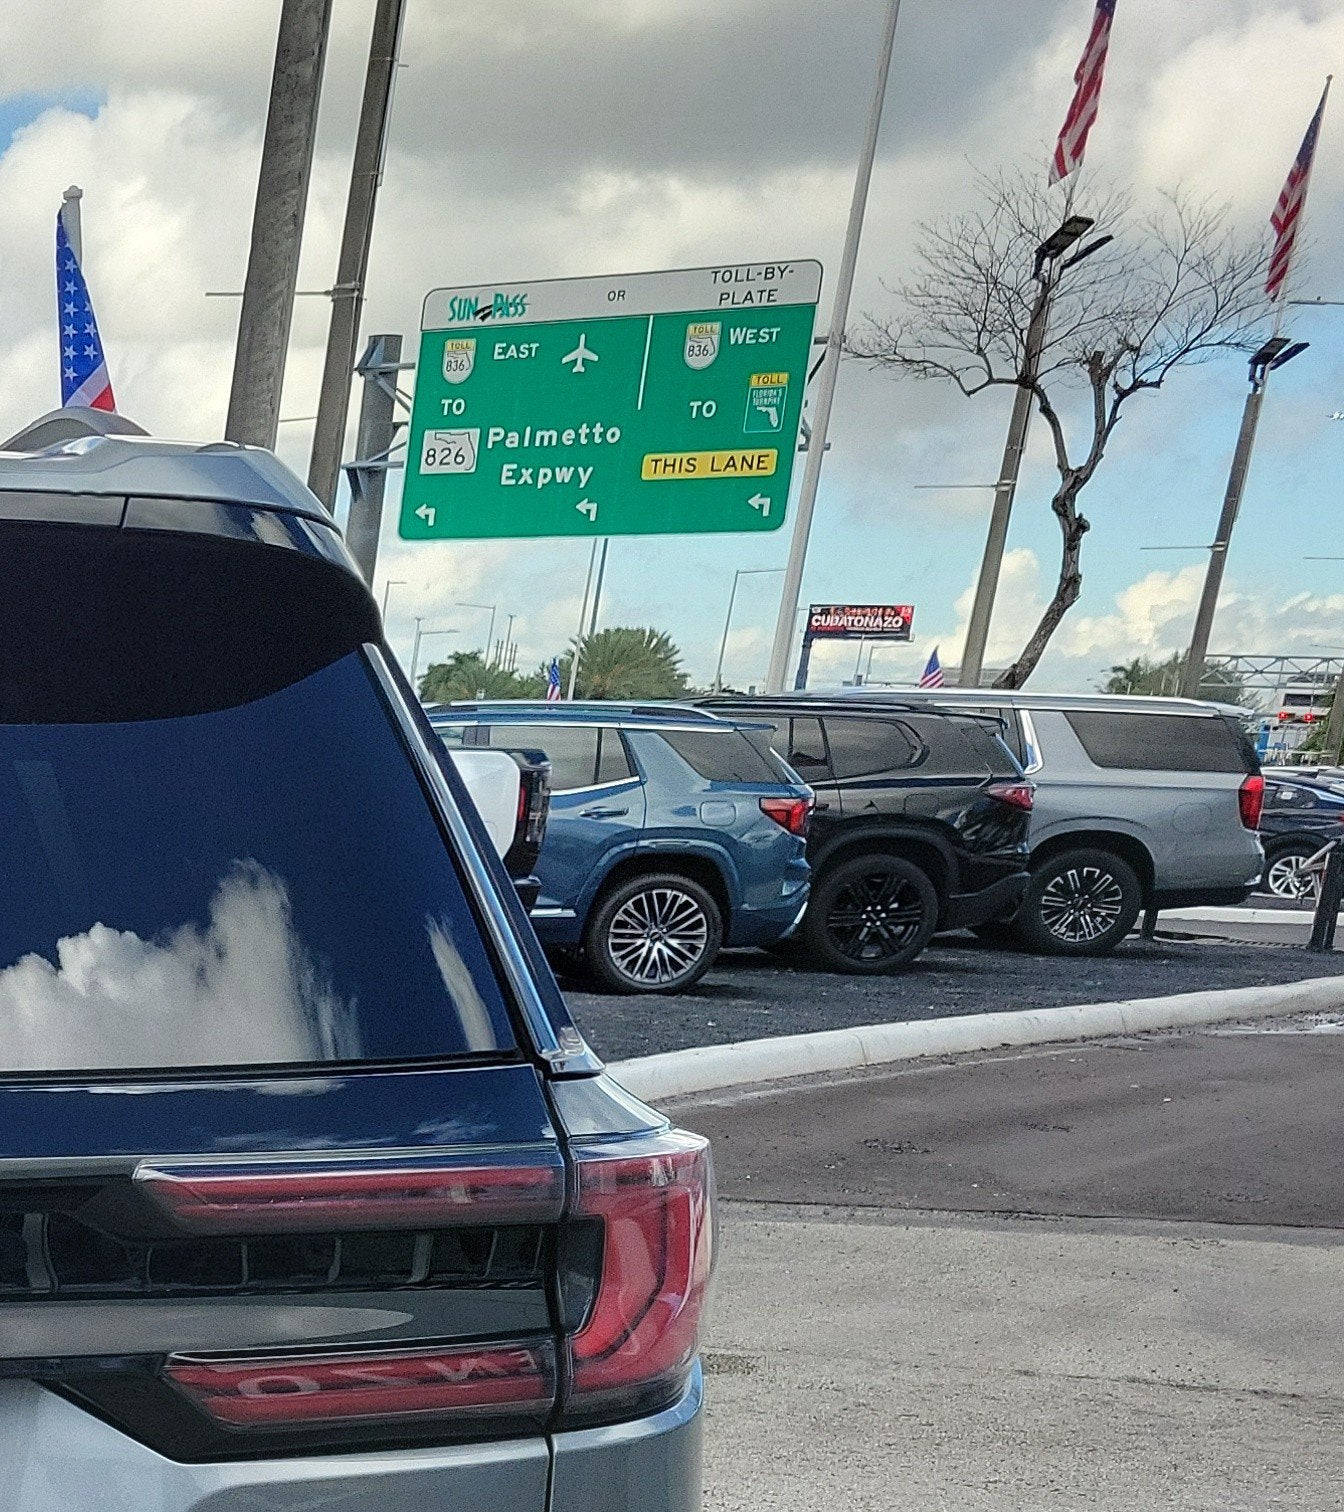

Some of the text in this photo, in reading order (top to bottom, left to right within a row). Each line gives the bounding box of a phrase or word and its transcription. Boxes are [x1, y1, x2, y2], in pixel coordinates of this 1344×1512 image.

[711, 265, 795, 285] TOLL-BY-
[607, 289, 626, 302] OR
[718, 289, 779, 306] PLATE
[692, 325, 716, 334] TOLL
[728, 327, 781, 345] WEST
[449, 342, 472, 350] TOLL
[492, 342, 540, 361] EAST
[687, 344, 710, 358] 836
[445, 359, 466, 373] 836
[756, 374, 784, 385] TOLL
[441, 398, 466, 416] TO
[688, 400, 717, 419] TO
[486, 421, 622, 449] Palmetto
[424, 447, 467, 468] 826
[650, 454, 770, 476] THIS LANE
[500, 463, 595, 490] Expwy
